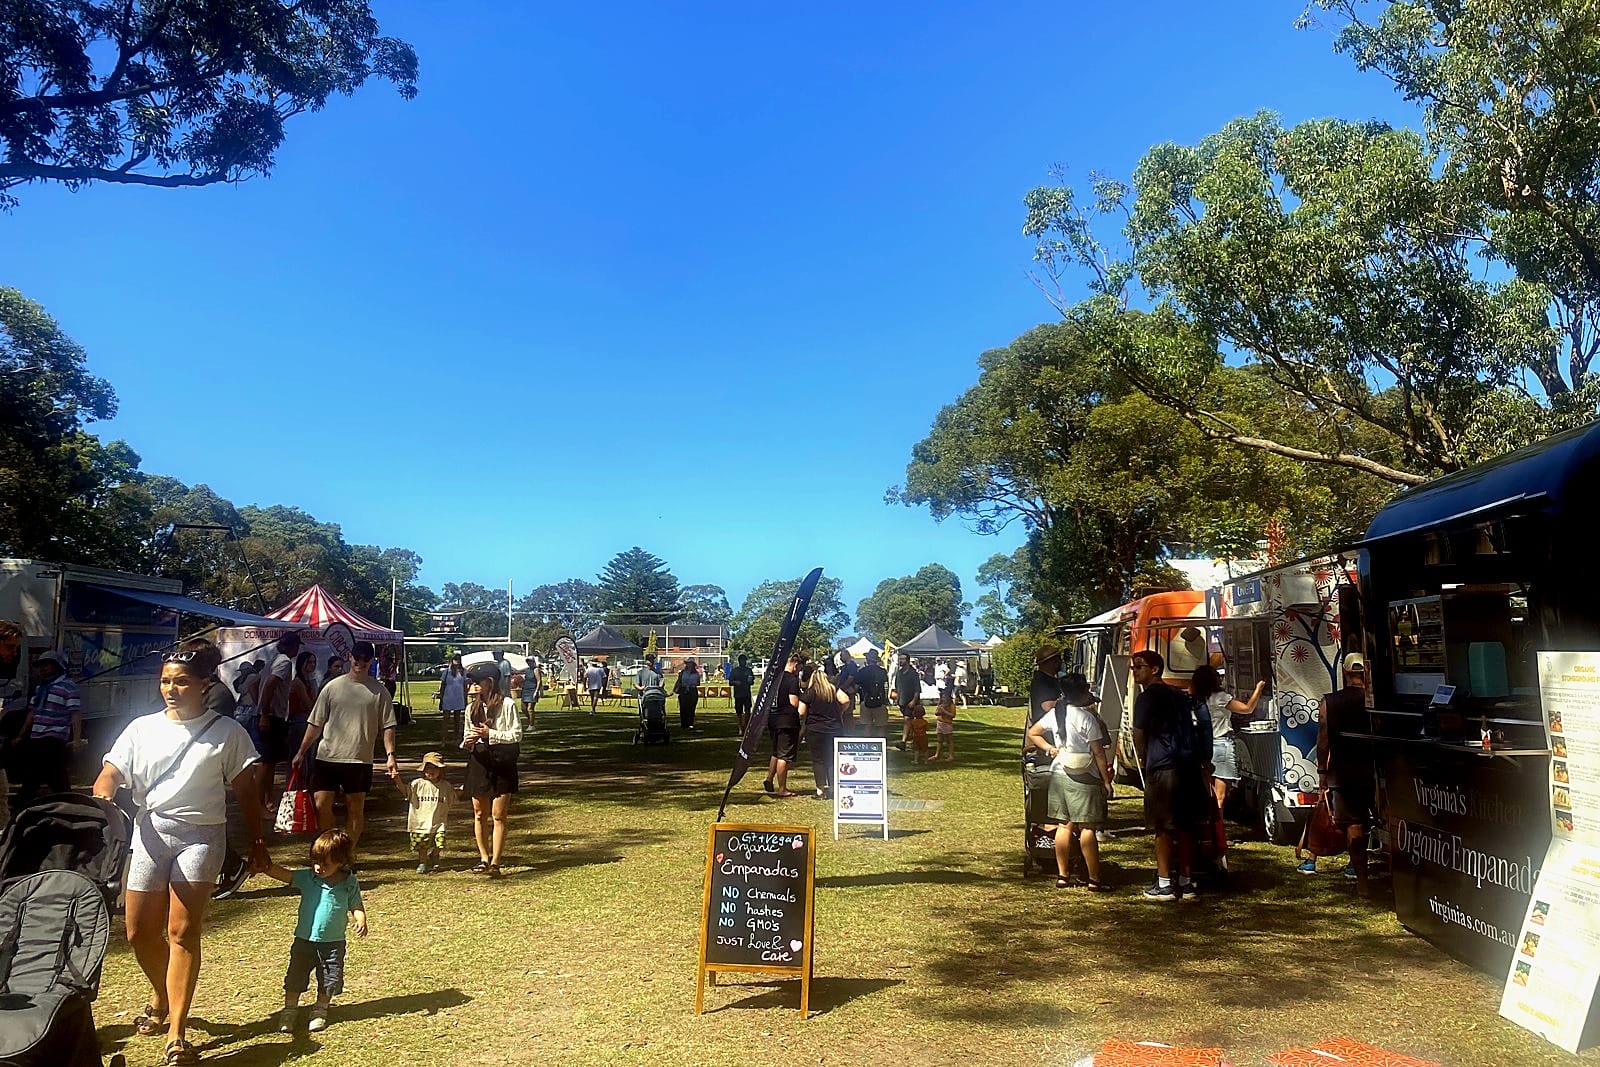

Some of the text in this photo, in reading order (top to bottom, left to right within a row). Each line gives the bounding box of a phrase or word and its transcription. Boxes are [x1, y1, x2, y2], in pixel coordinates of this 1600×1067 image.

[329, 630, 350, 657] CIRCU
[1413, 777, 1467, 816] Virginia's
[728, 835, 780, 861] Organic
[1397, 819, 1450, 866] Organic
[720, 859, 799, 882] Empanadas
[722, 885, 740, 899] NO
[720, 901, 736, 914] NO
[718, 916, 780, 932] NO GMO's
[1429, 895, 1516, 949] virginias.com.au
[716, 935, 744, 947] JUST
